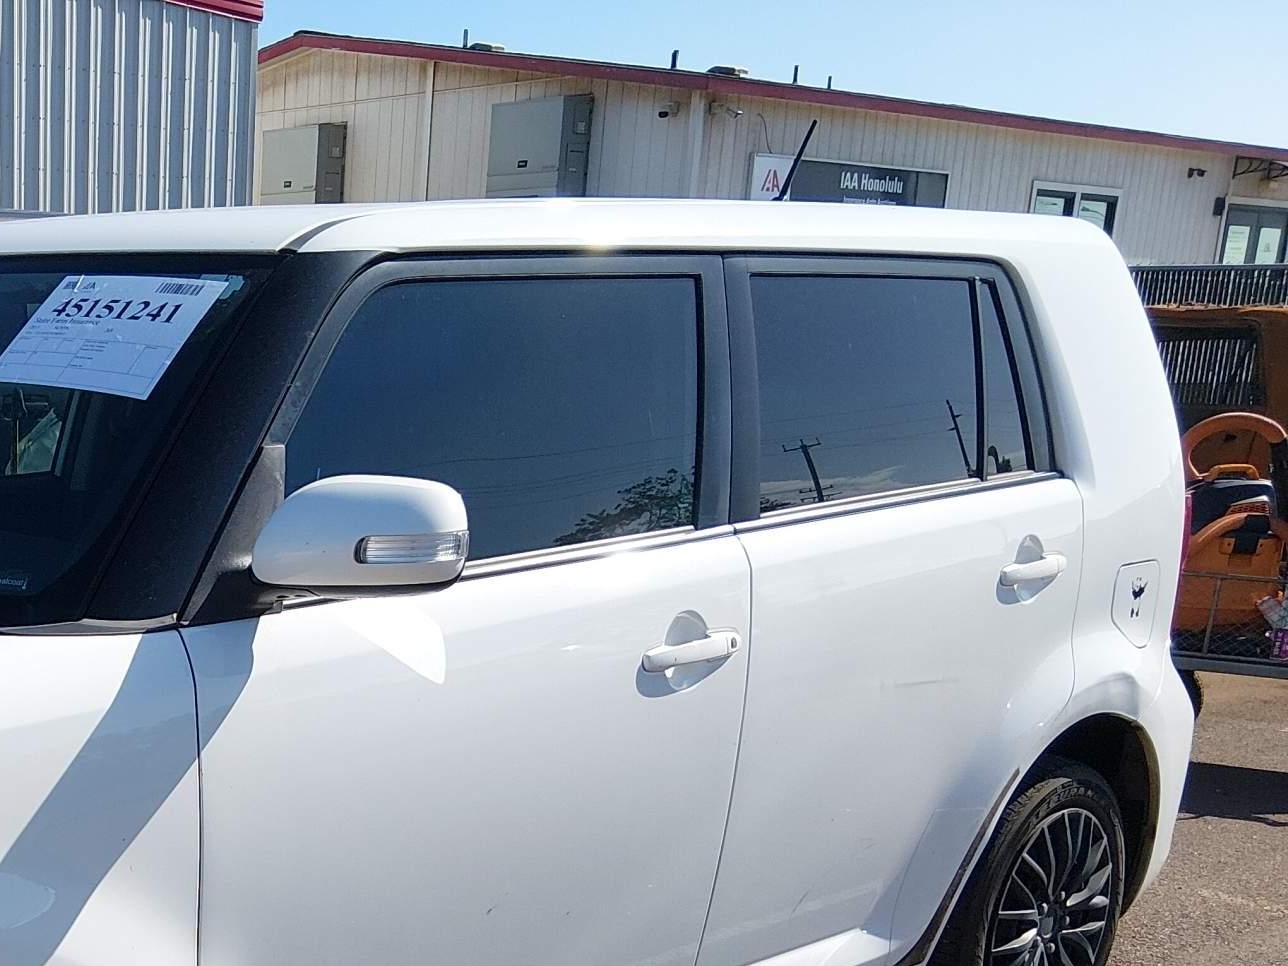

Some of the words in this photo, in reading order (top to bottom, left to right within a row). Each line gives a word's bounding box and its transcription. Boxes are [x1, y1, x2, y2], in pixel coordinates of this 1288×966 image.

[840, 171, 858, 190] IAA
[861, 173, 904, 194] Honolulu
[52, 297, 184, 324] 45151241
